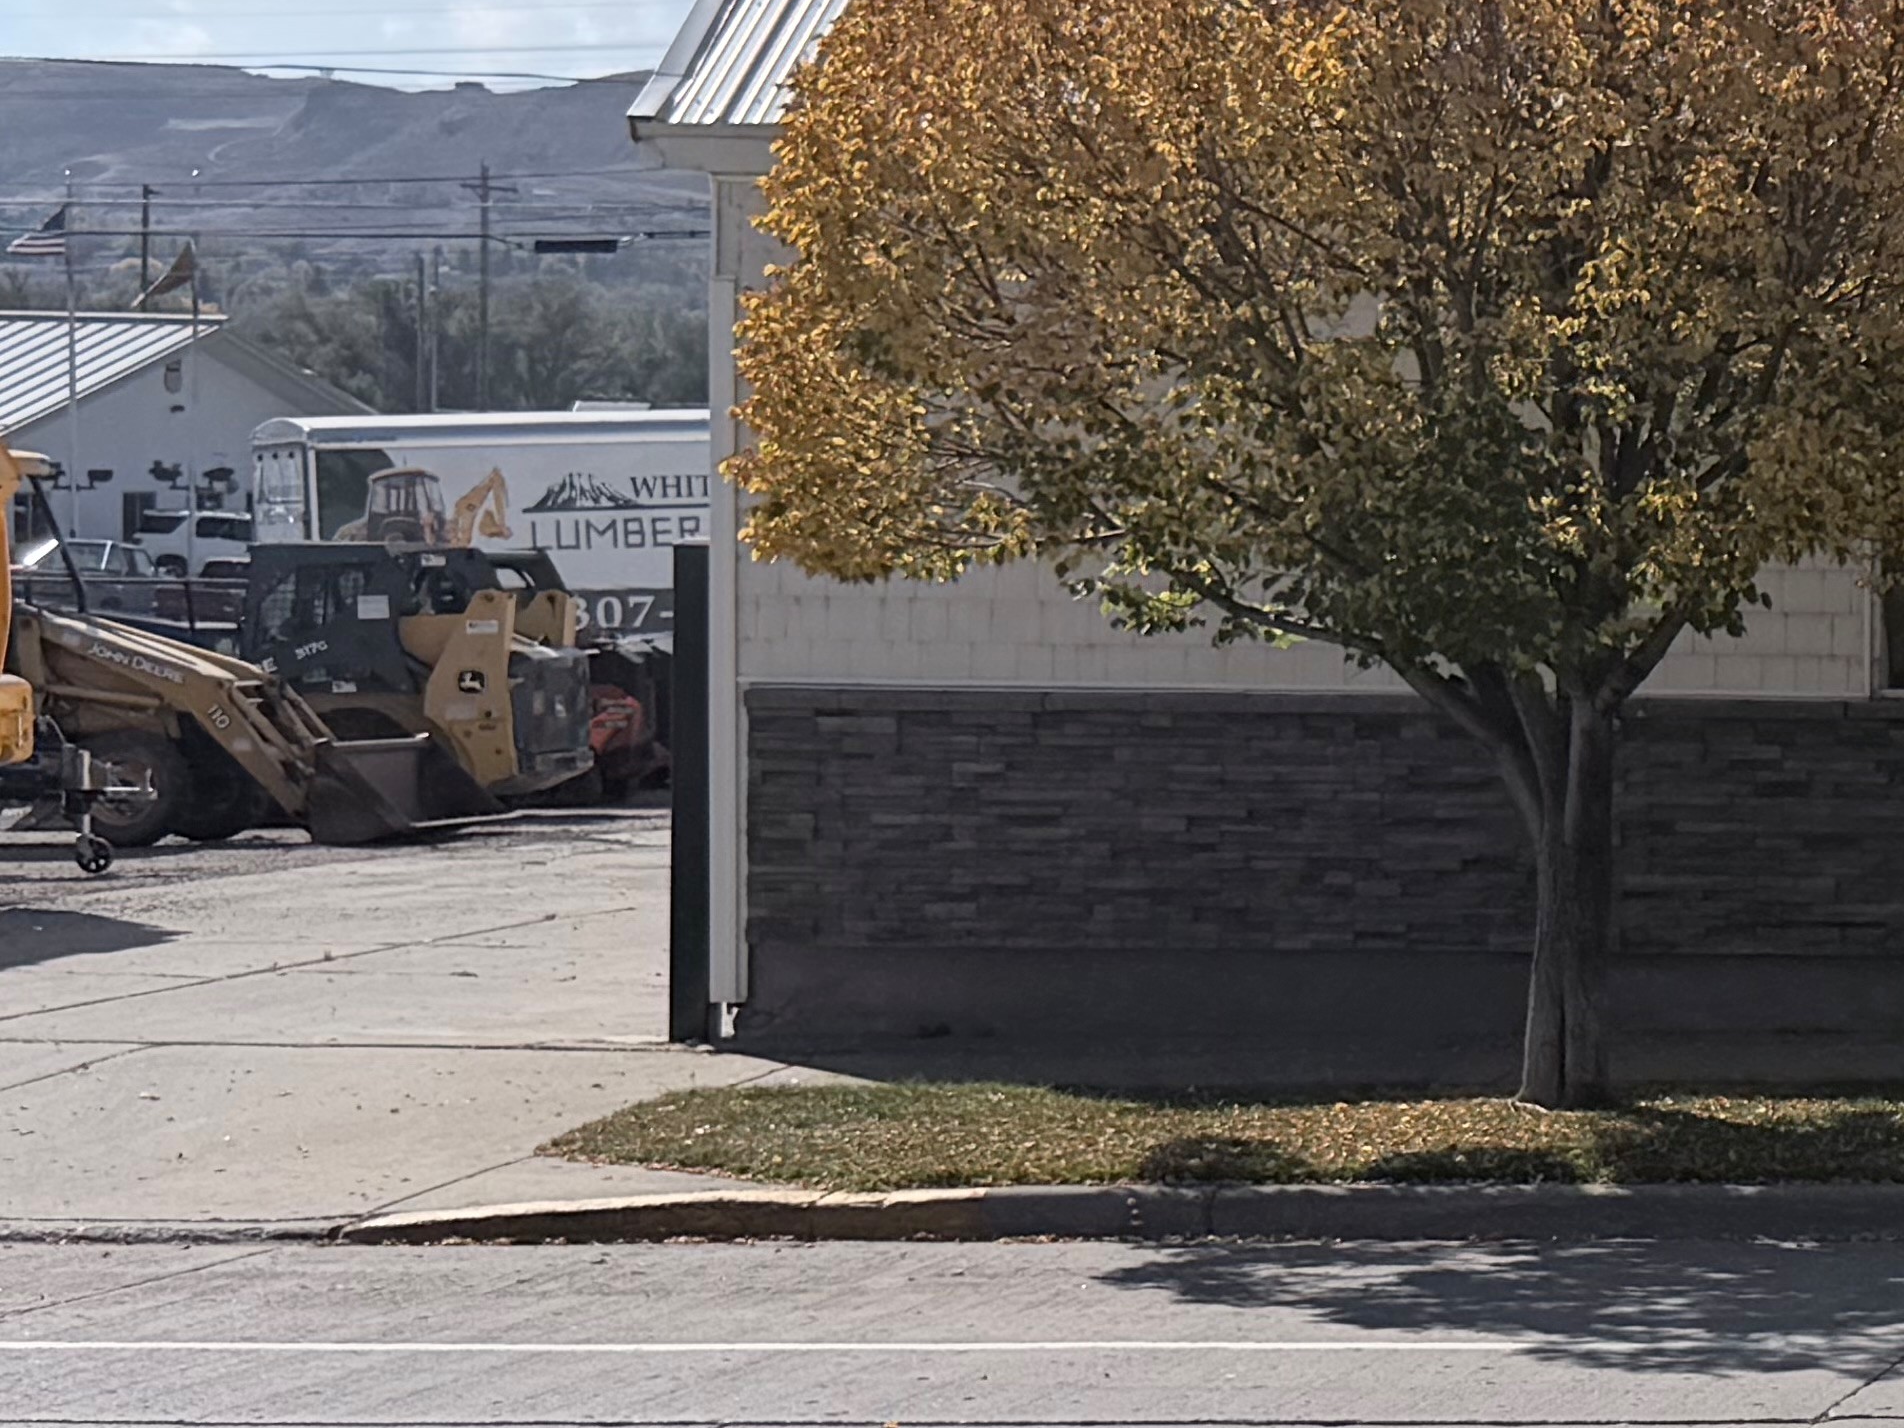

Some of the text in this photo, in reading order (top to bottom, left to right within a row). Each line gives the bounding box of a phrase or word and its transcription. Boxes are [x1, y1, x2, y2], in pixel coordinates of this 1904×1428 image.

[531, 515, 701, 551] LUMBER
[87, 641, 184, 685] JOHN DEERE
